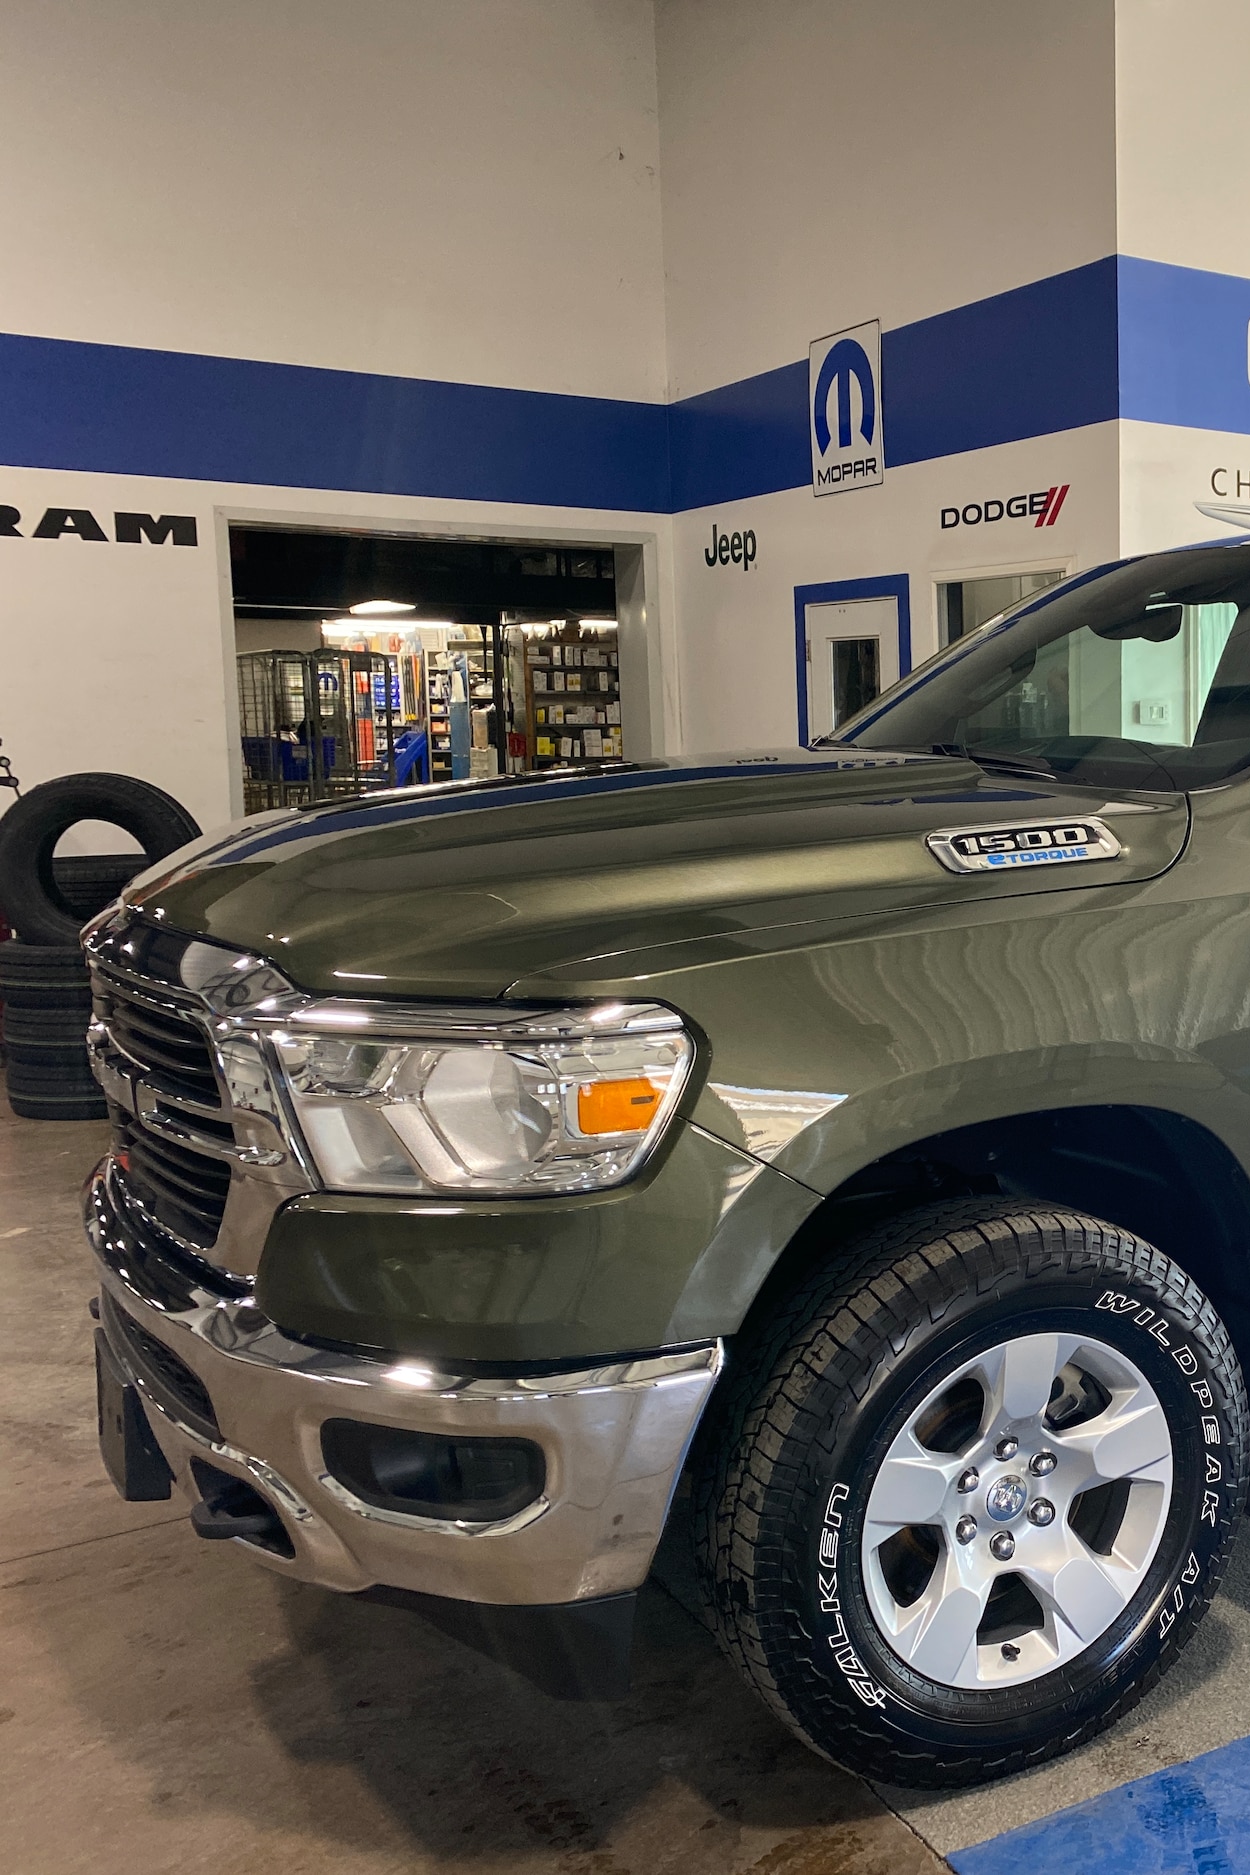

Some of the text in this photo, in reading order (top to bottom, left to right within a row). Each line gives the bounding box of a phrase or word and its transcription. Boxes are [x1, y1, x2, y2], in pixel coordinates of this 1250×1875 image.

[817, 457, 877, 487] MOPAR
[941, 491, 1050, 529] DODGE
[705, 524, 757, 572] Jeep
[958, 827, 1088, 854] 1500
[1095, 1291, 1221, 1527] WILDPEAK
[818, 1482, 886, 1709] FALKEN
